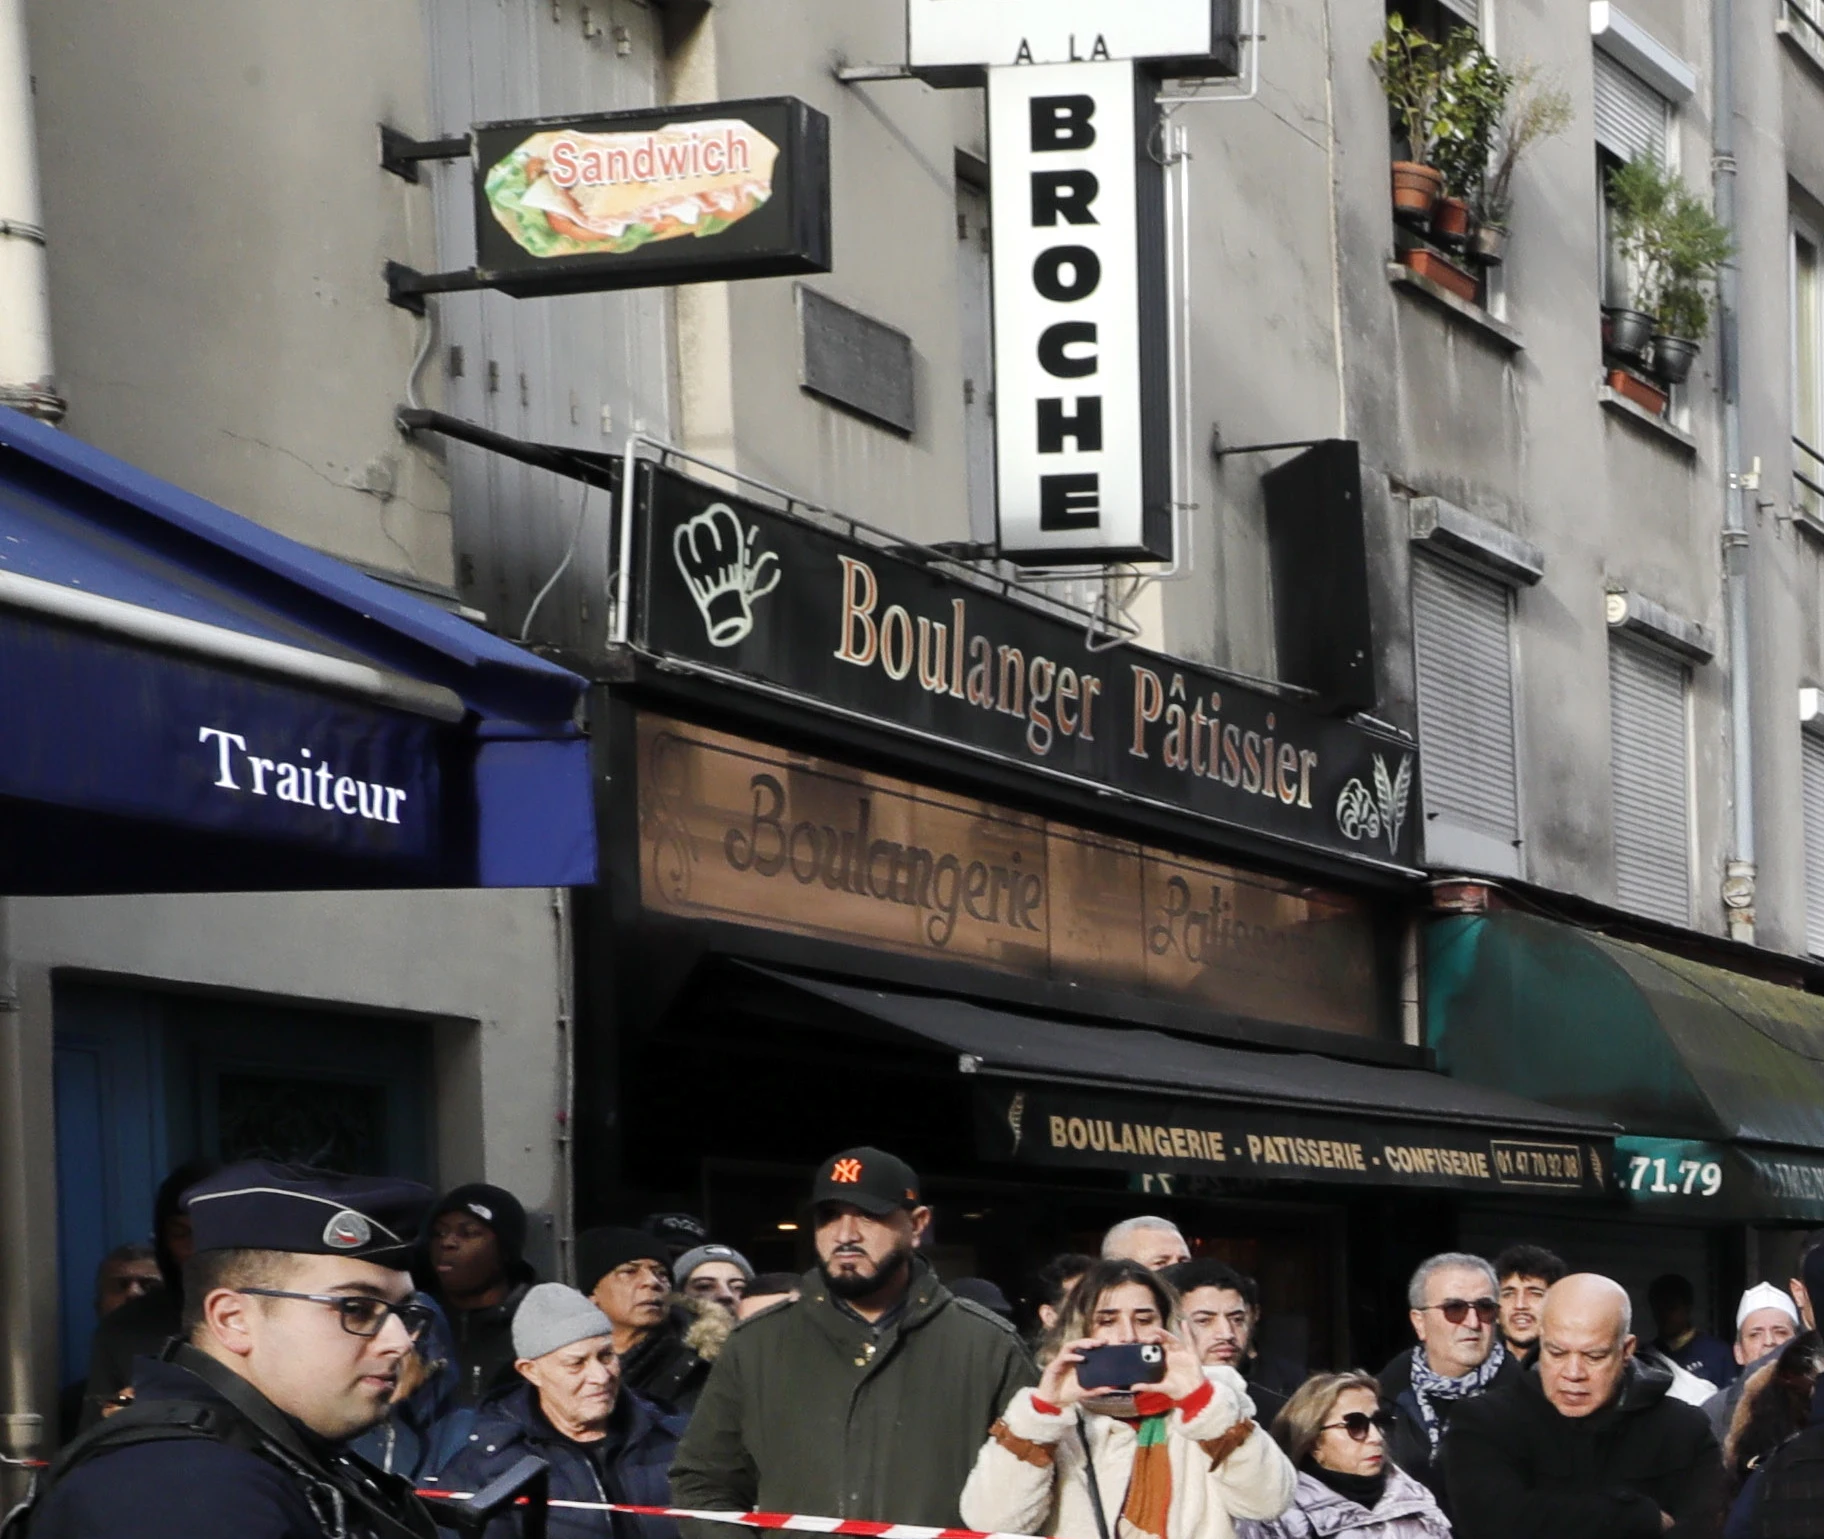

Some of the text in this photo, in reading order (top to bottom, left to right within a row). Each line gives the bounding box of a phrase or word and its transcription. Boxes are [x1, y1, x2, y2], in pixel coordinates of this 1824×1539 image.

[1015, 34, 1110, 65] A LA
[547, 128, 754, 190] Sandwich
[1028, 92, 1102, 531] BROCHE
[833, 553, 1319, 810] Boulanger Pâtissier
[198, 727, 407, 827] Traiteur
[724, 772, 1045, 949] Boulangerie
[830, 1158, 864, 1183] NY
[1049, 1114, 1226, 1162] BOULANGERIE
[1249, 1134, 1367, 1171] PATISSERIE
[1385, 1144, 1490, 1179] CONFISERIE
